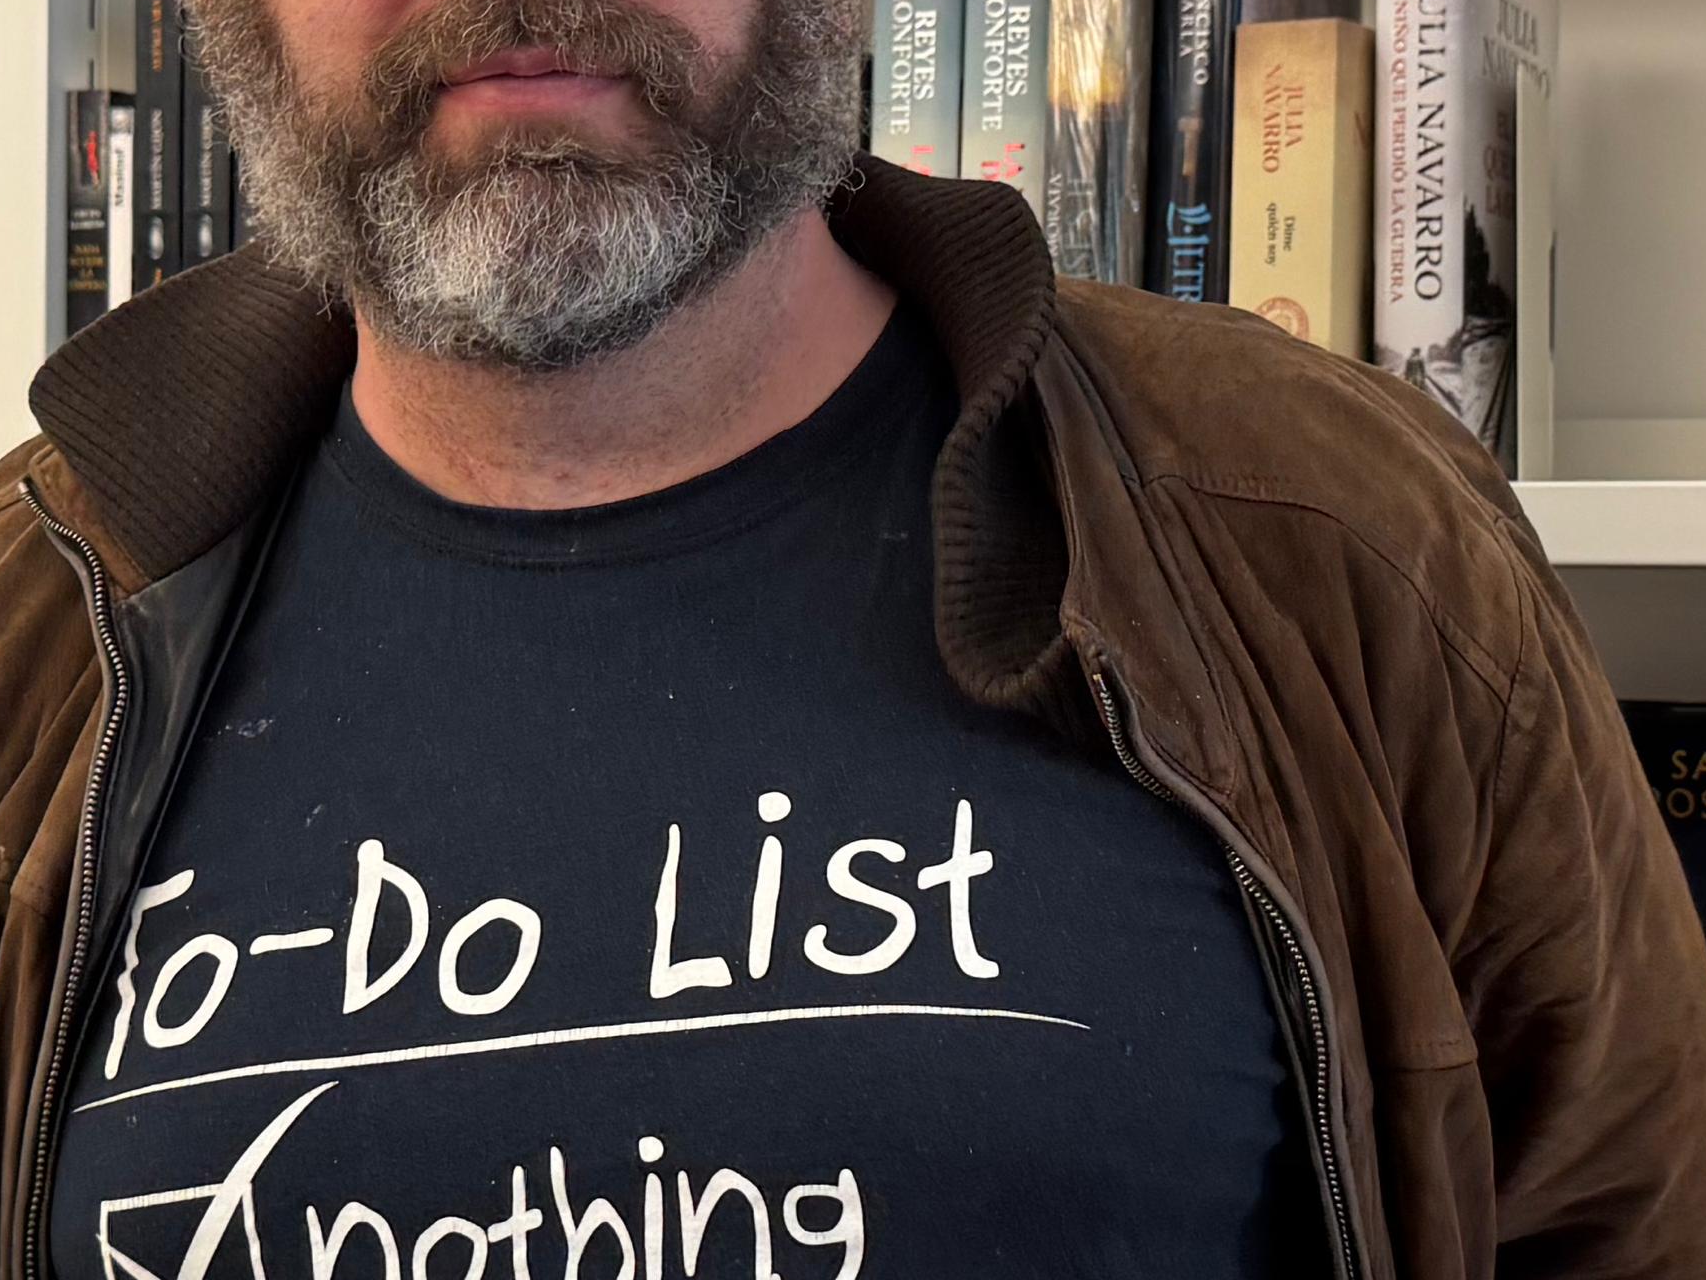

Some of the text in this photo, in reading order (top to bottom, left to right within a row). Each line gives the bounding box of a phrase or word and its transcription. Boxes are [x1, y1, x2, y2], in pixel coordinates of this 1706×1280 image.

[1007, 5, 1031, 97] REYES
[1412, 100, 1448, 301] NAVARRO
[105, 792, 1000, 1080] To-Do List
